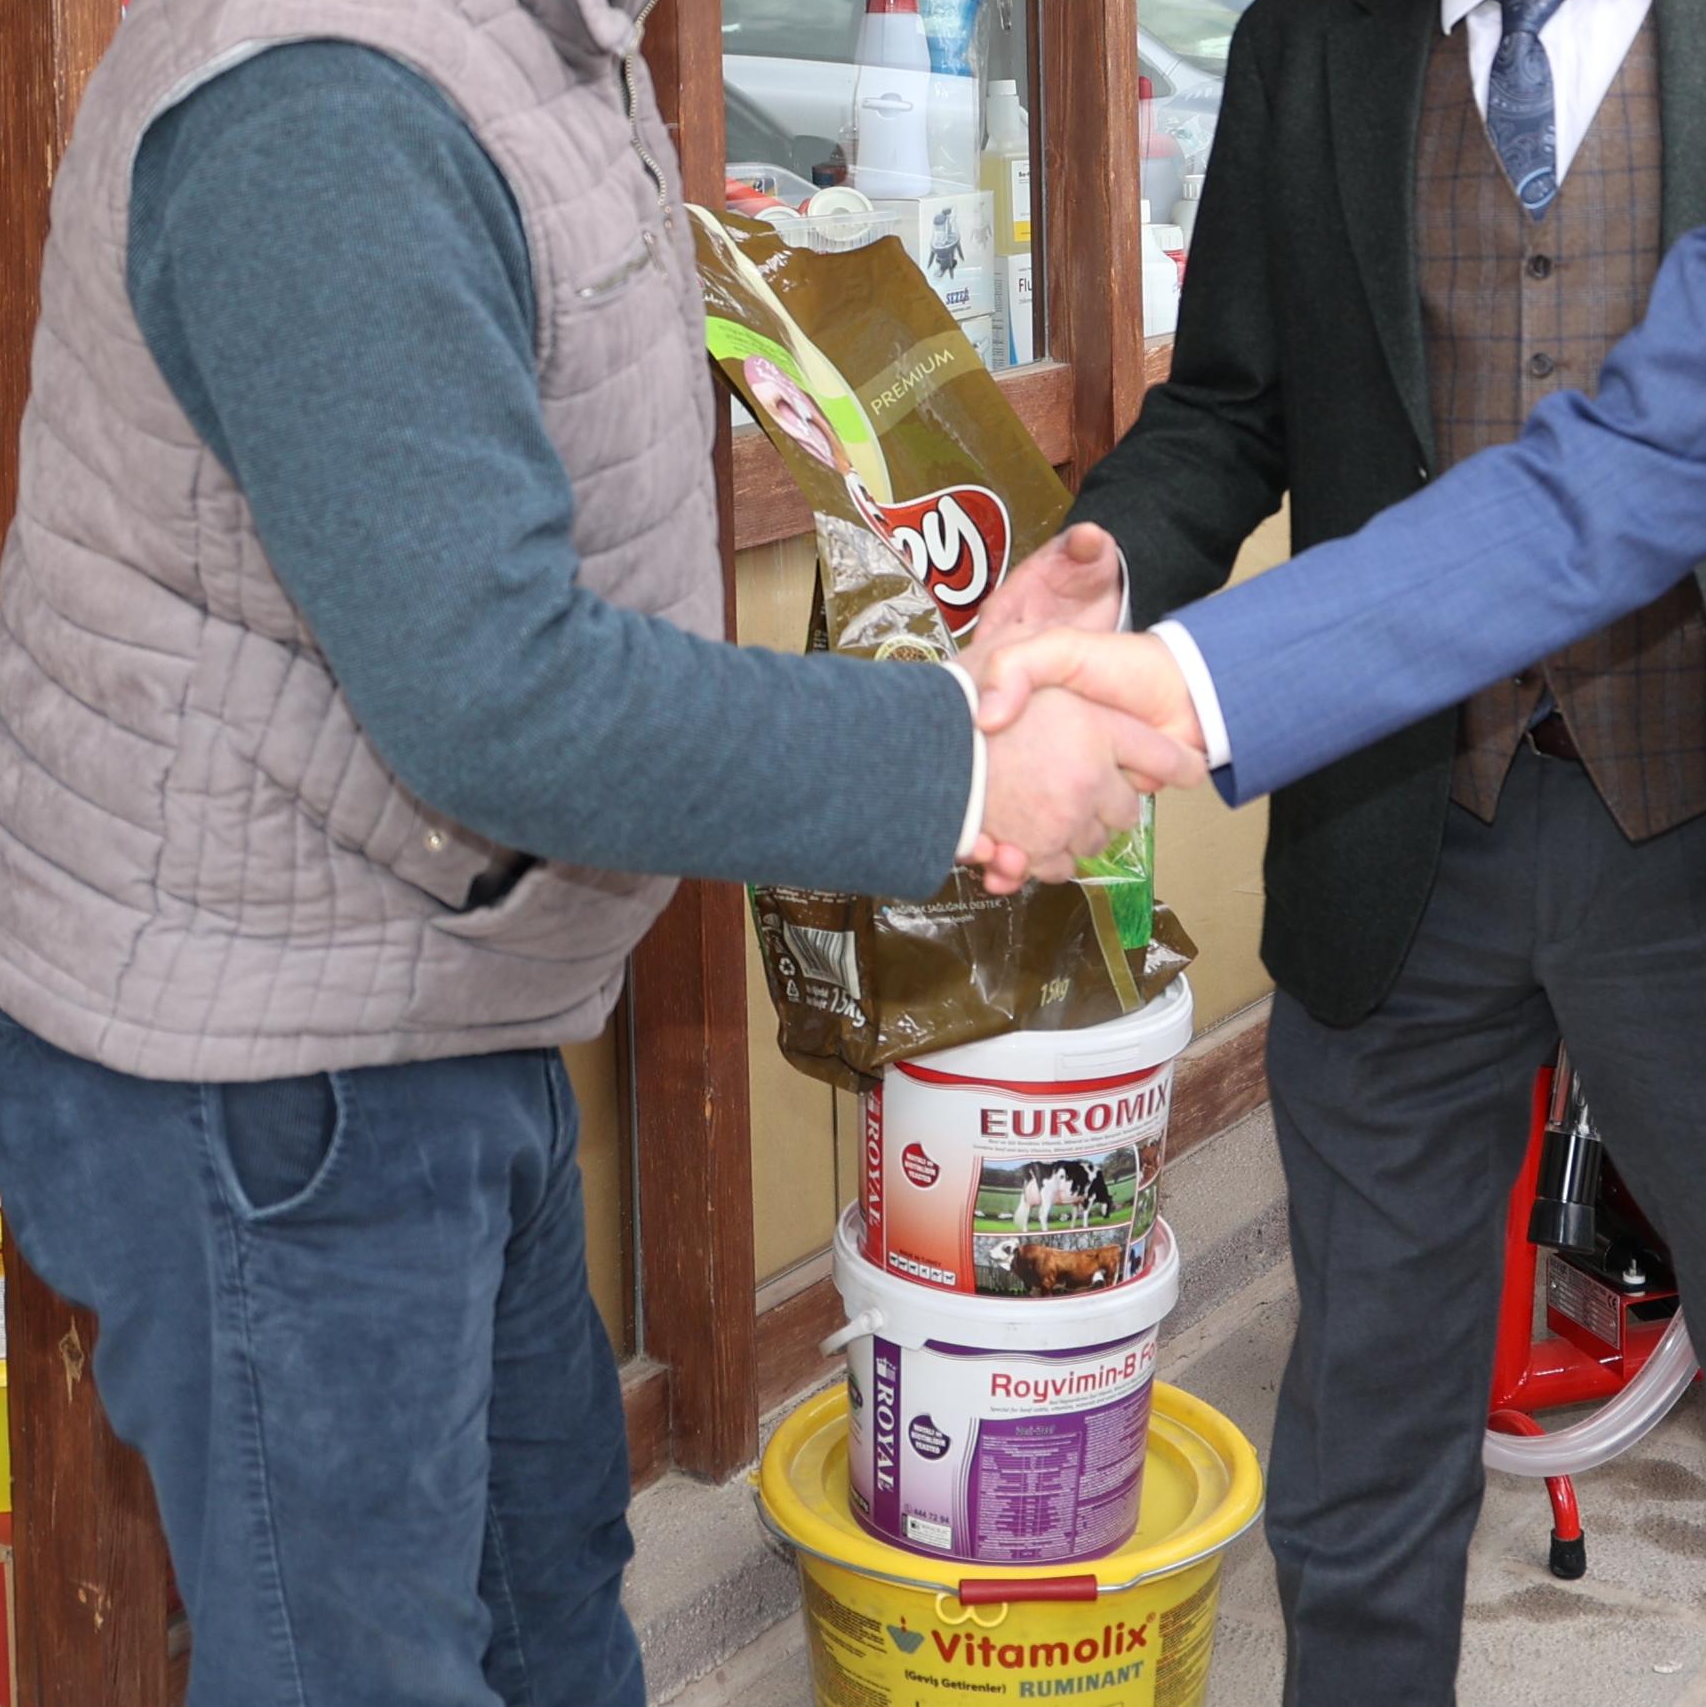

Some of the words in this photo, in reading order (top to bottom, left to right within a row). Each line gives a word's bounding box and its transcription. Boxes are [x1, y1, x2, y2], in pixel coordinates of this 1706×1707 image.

[870, 348, 954, 415] PREMIUM
[1039, 978, 1070, 1007] 15kg
[980, 1078, 1169, 1138] EUROMIX
[867, 1119, 882, 1227] ROYAL
[991, 1352, 1136, 1403] Royvimin-B
[876, 1379, 896, 1492] ROYAL
[931, 1622, 1149, 1669] Vitamolix
[941, 1674, 1007, 1695] Getirenler)
[1019, 1661, 1144, 1699] RUMINANT
